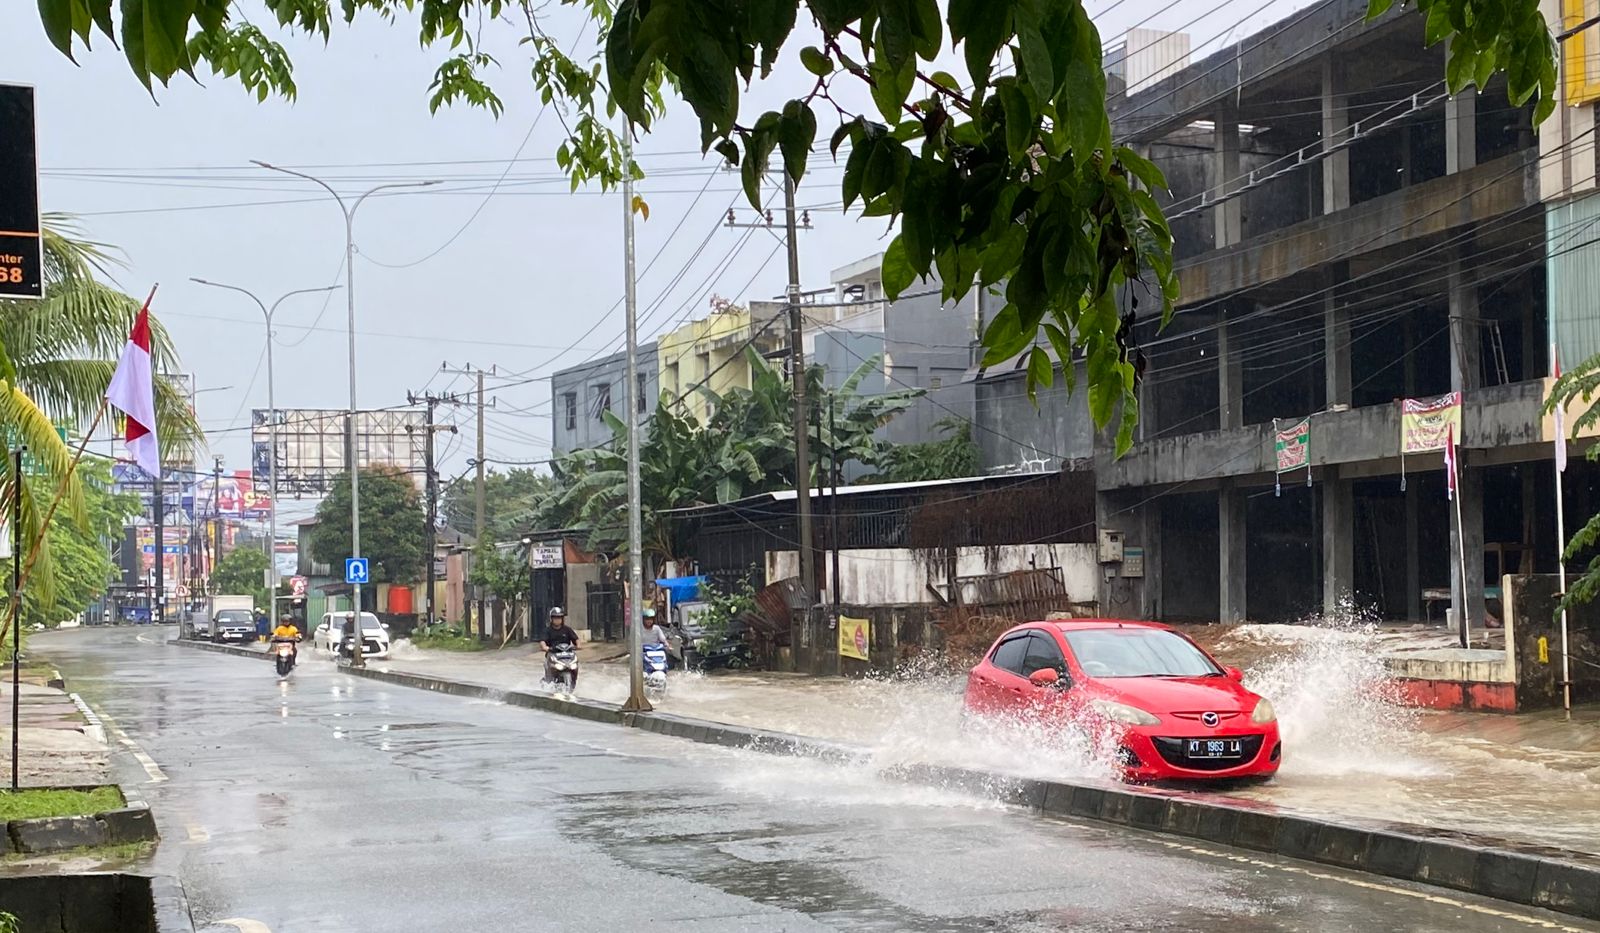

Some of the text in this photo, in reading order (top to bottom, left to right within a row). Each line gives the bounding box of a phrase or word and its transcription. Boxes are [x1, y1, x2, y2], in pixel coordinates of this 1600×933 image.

[1190, 740, 1240, 752] KT 1963 LA
